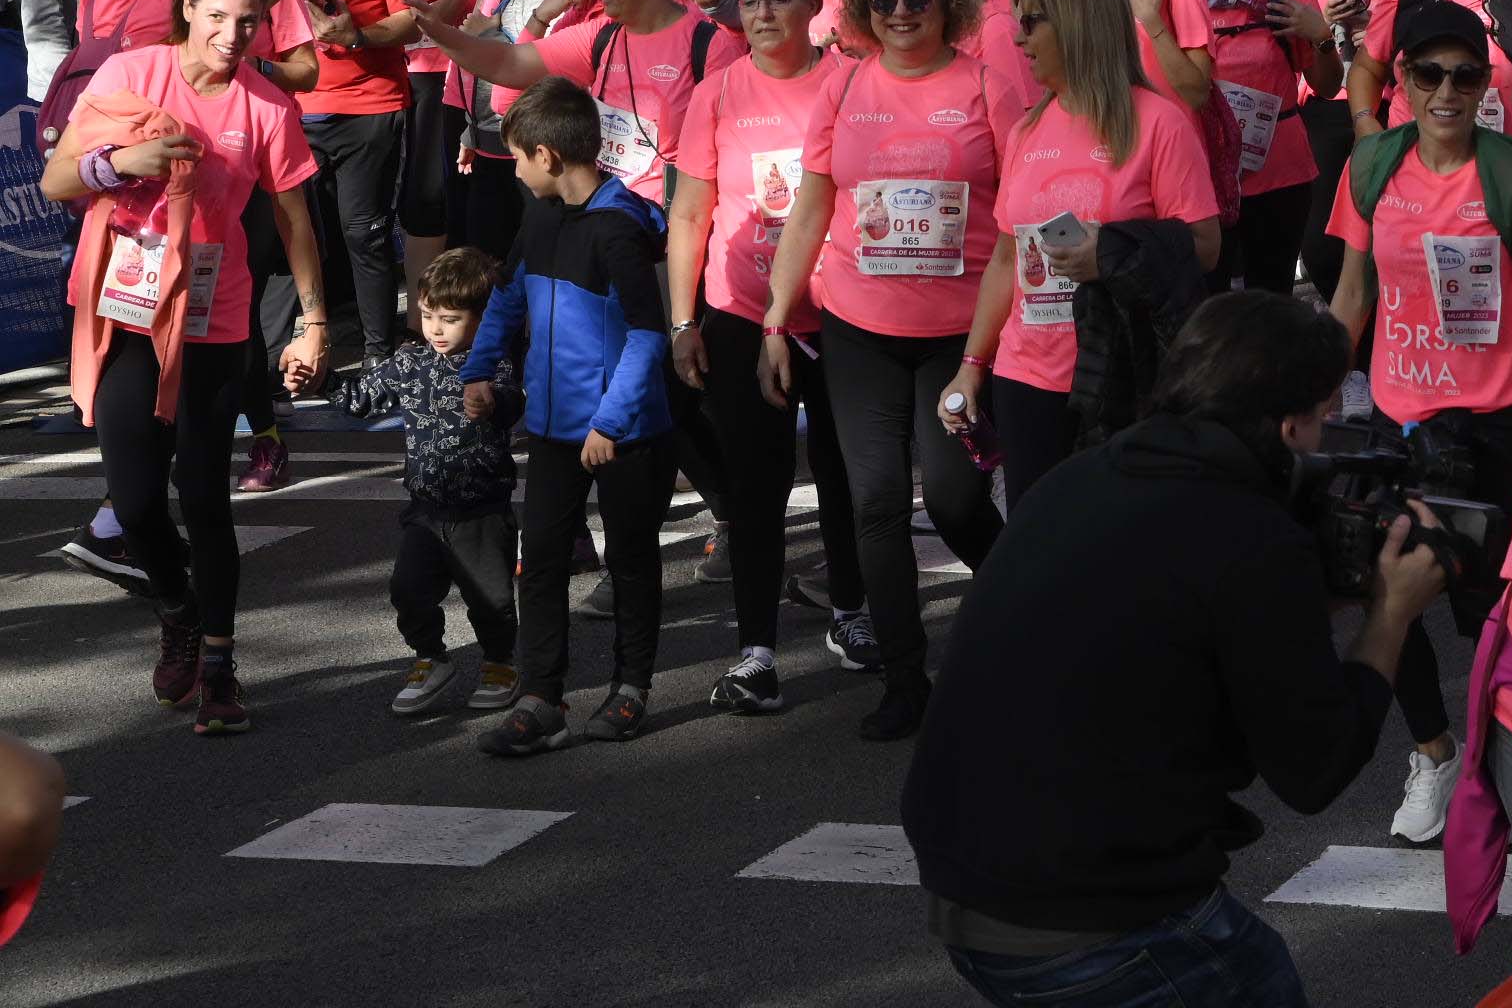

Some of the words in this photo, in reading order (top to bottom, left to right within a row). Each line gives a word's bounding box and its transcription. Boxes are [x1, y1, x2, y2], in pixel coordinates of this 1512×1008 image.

[737, 116, 782, 128] OYSHO
[850, 112, 894, 123] OYSHO
[893, 195, 934, 206] ASTURIANA
[893, 218, 930, 232] 016
[901, 236, 920, 246] 865
[870, 248, 898, 256] CARRERA
[924, 263, 955, 272] Santander
[1058, 281, 1074, 290] 866
[109, 304, 142, 319] OYSHO
[1454, 327, 1491, 335] Santander
